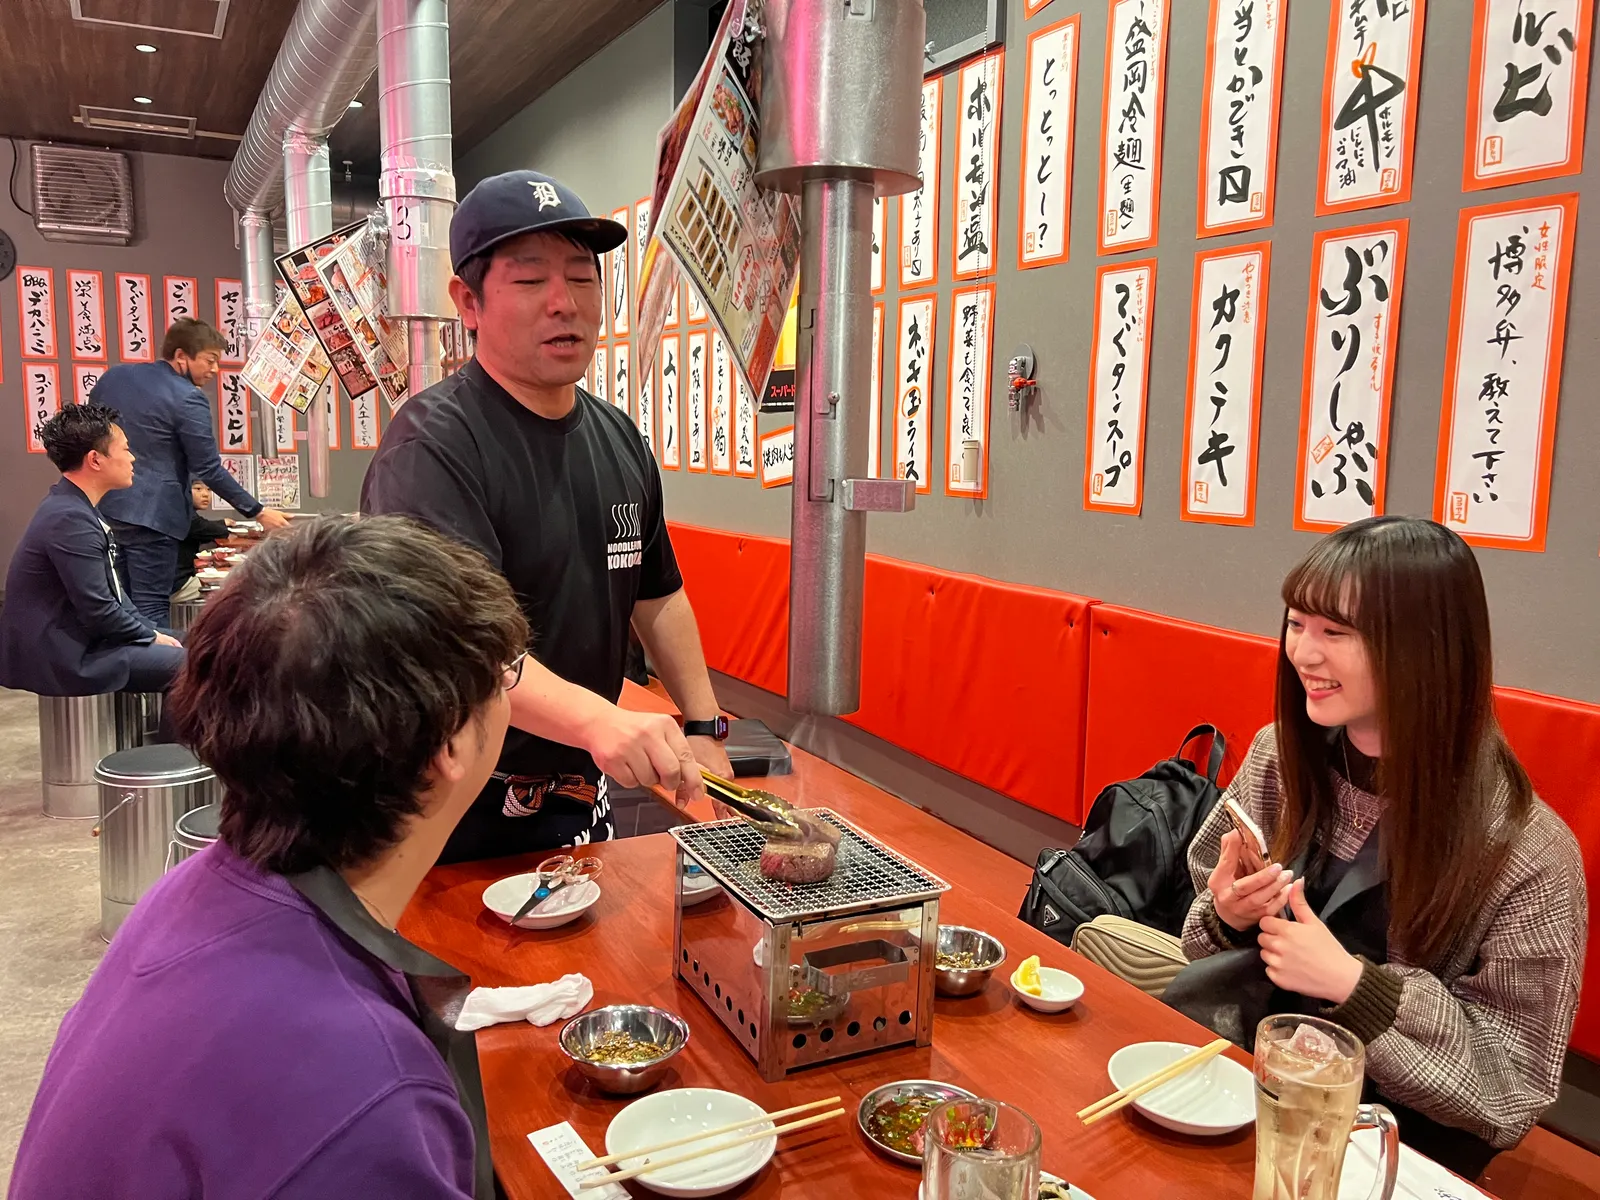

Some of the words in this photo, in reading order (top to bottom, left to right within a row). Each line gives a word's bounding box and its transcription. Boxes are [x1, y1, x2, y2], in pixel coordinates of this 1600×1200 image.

[527, 181, 562, 212] D
[396, 205, 412, 241] 3
[22, 274, 48, 288] BBQ
[171, 282, 189, 321] ごっつ
[249, 321, 259, 338] 5
[1311, 240, 1390, 506] ぶりしゃぶ
